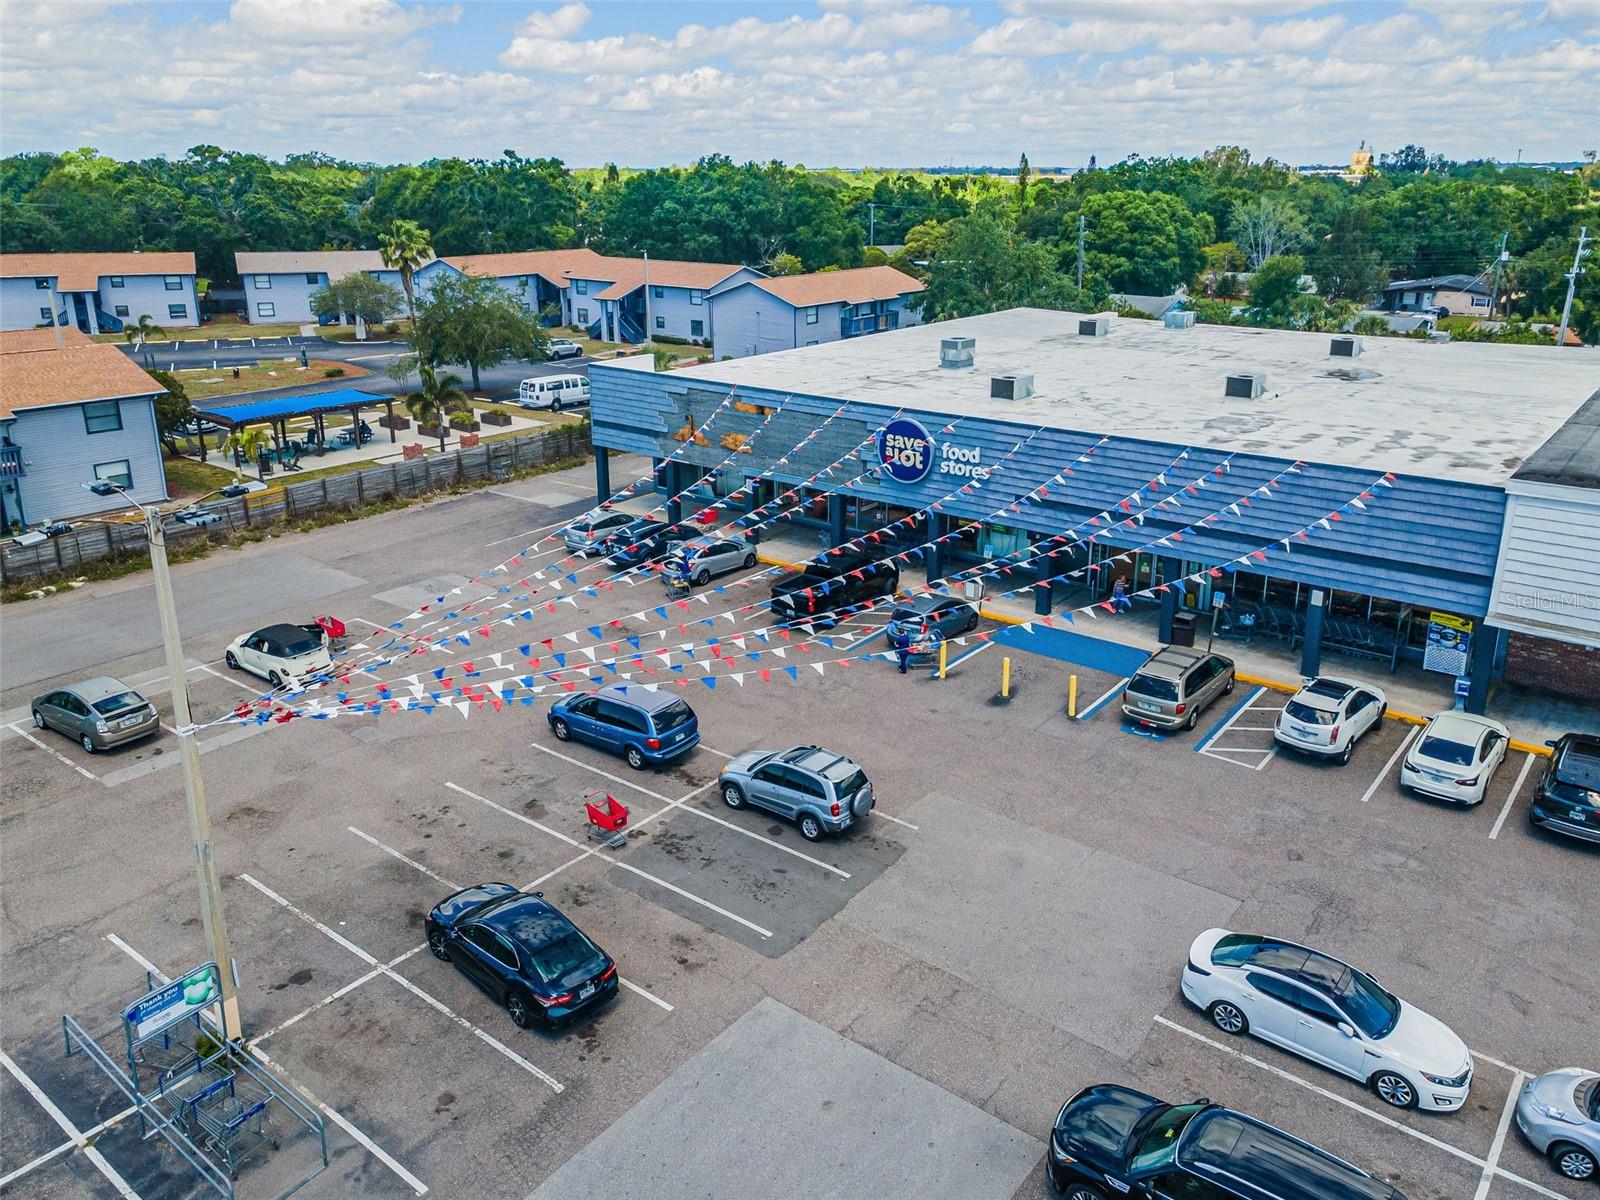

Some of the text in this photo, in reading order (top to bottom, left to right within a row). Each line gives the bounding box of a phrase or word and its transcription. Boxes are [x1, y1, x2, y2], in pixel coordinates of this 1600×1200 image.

[886, 433, 924, 452] save
[941, 442, 980, 464] food
[885, 446, 923, 469] a lot
[940, 460, 991, 480] stores
[139, 994, 162, 1010] Thank
[163, 987, 178, 998] you
